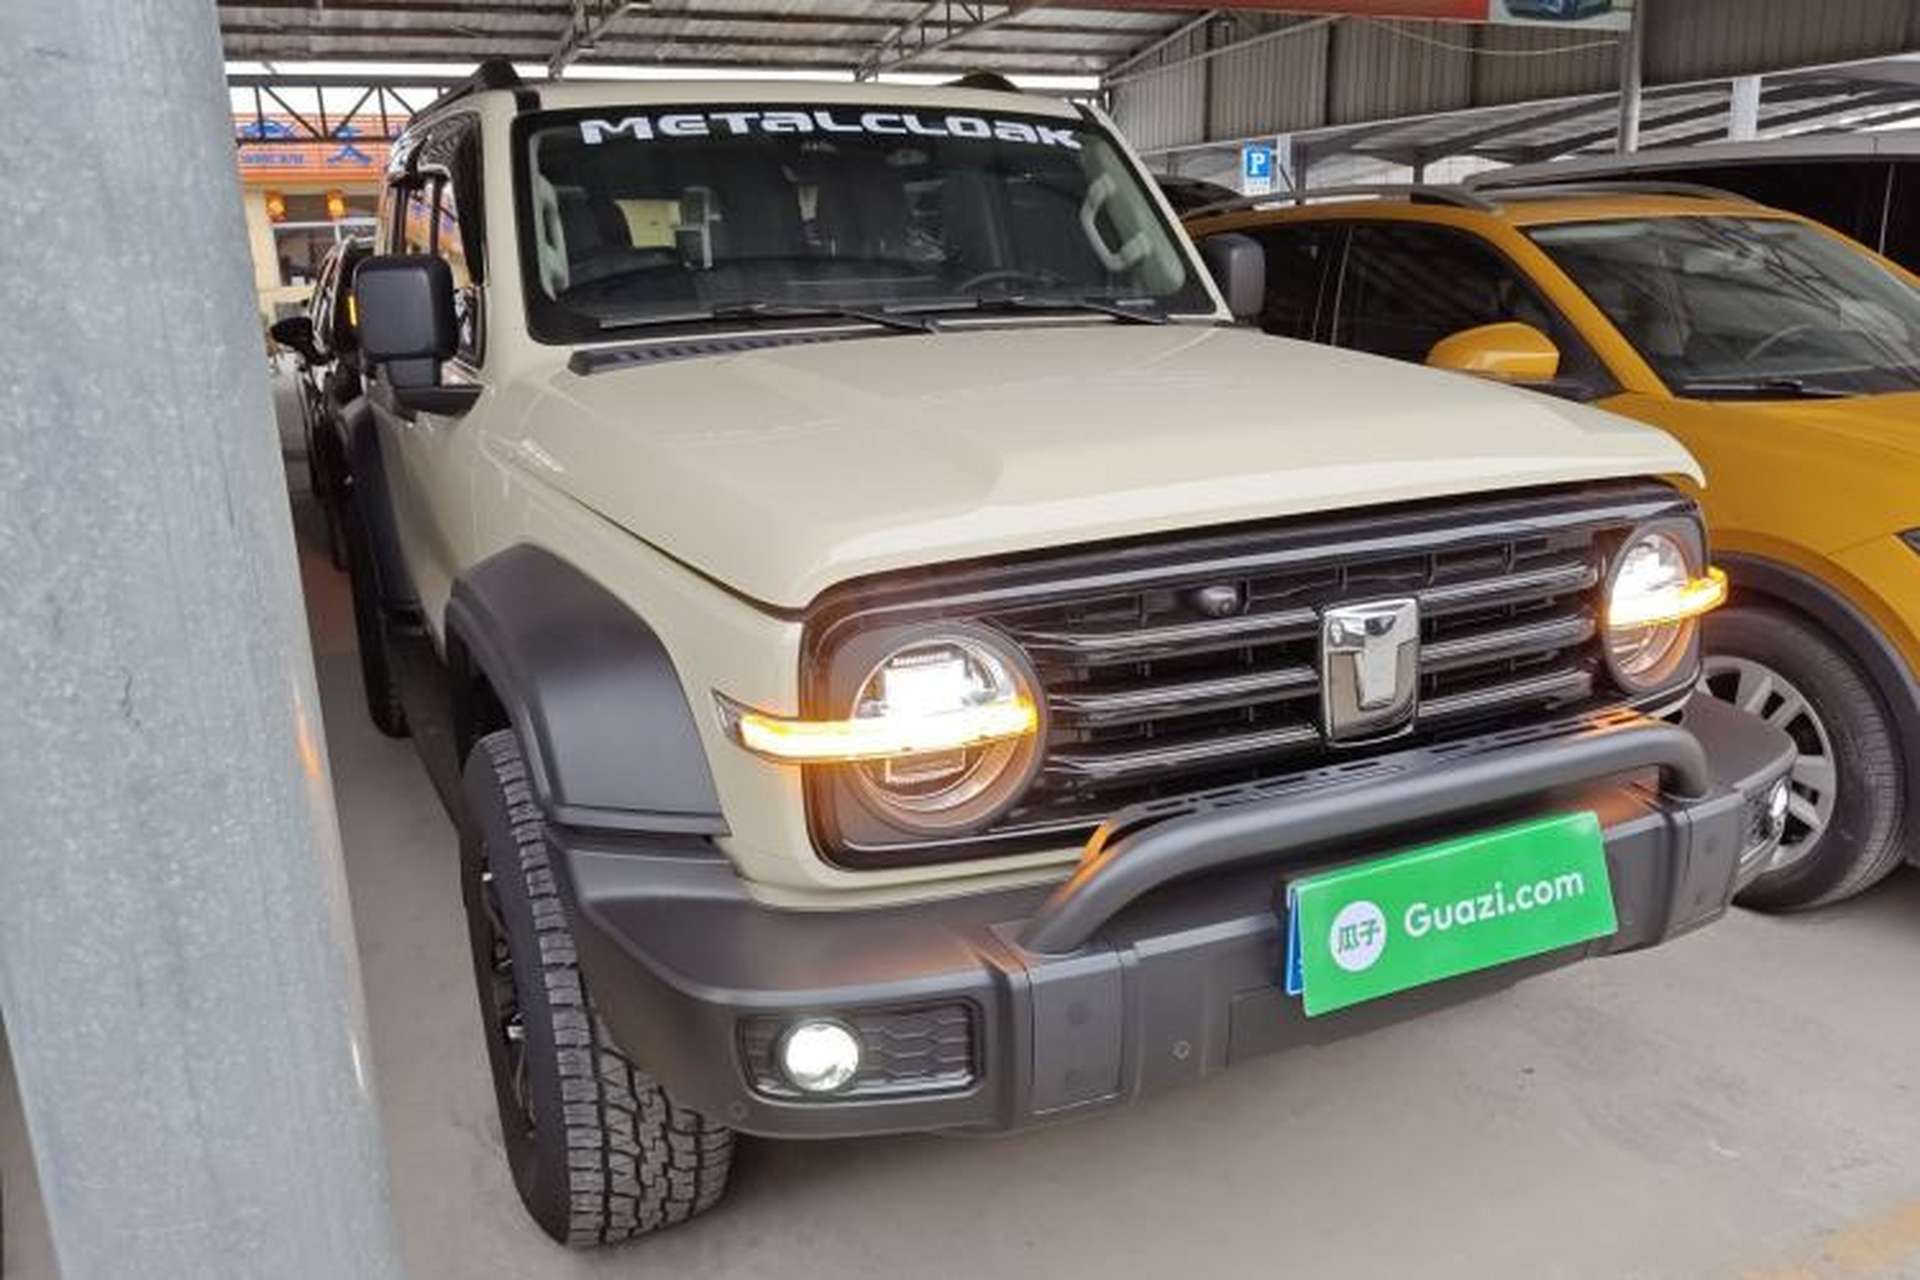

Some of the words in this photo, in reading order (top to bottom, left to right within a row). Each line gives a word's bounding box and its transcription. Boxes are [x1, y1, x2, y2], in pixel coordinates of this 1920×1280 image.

[1249, 152, 1266, 175] P
[1404, 871, 1584, 938] Guazi.com
[1338, 919, 1381, 954] 瓜子
